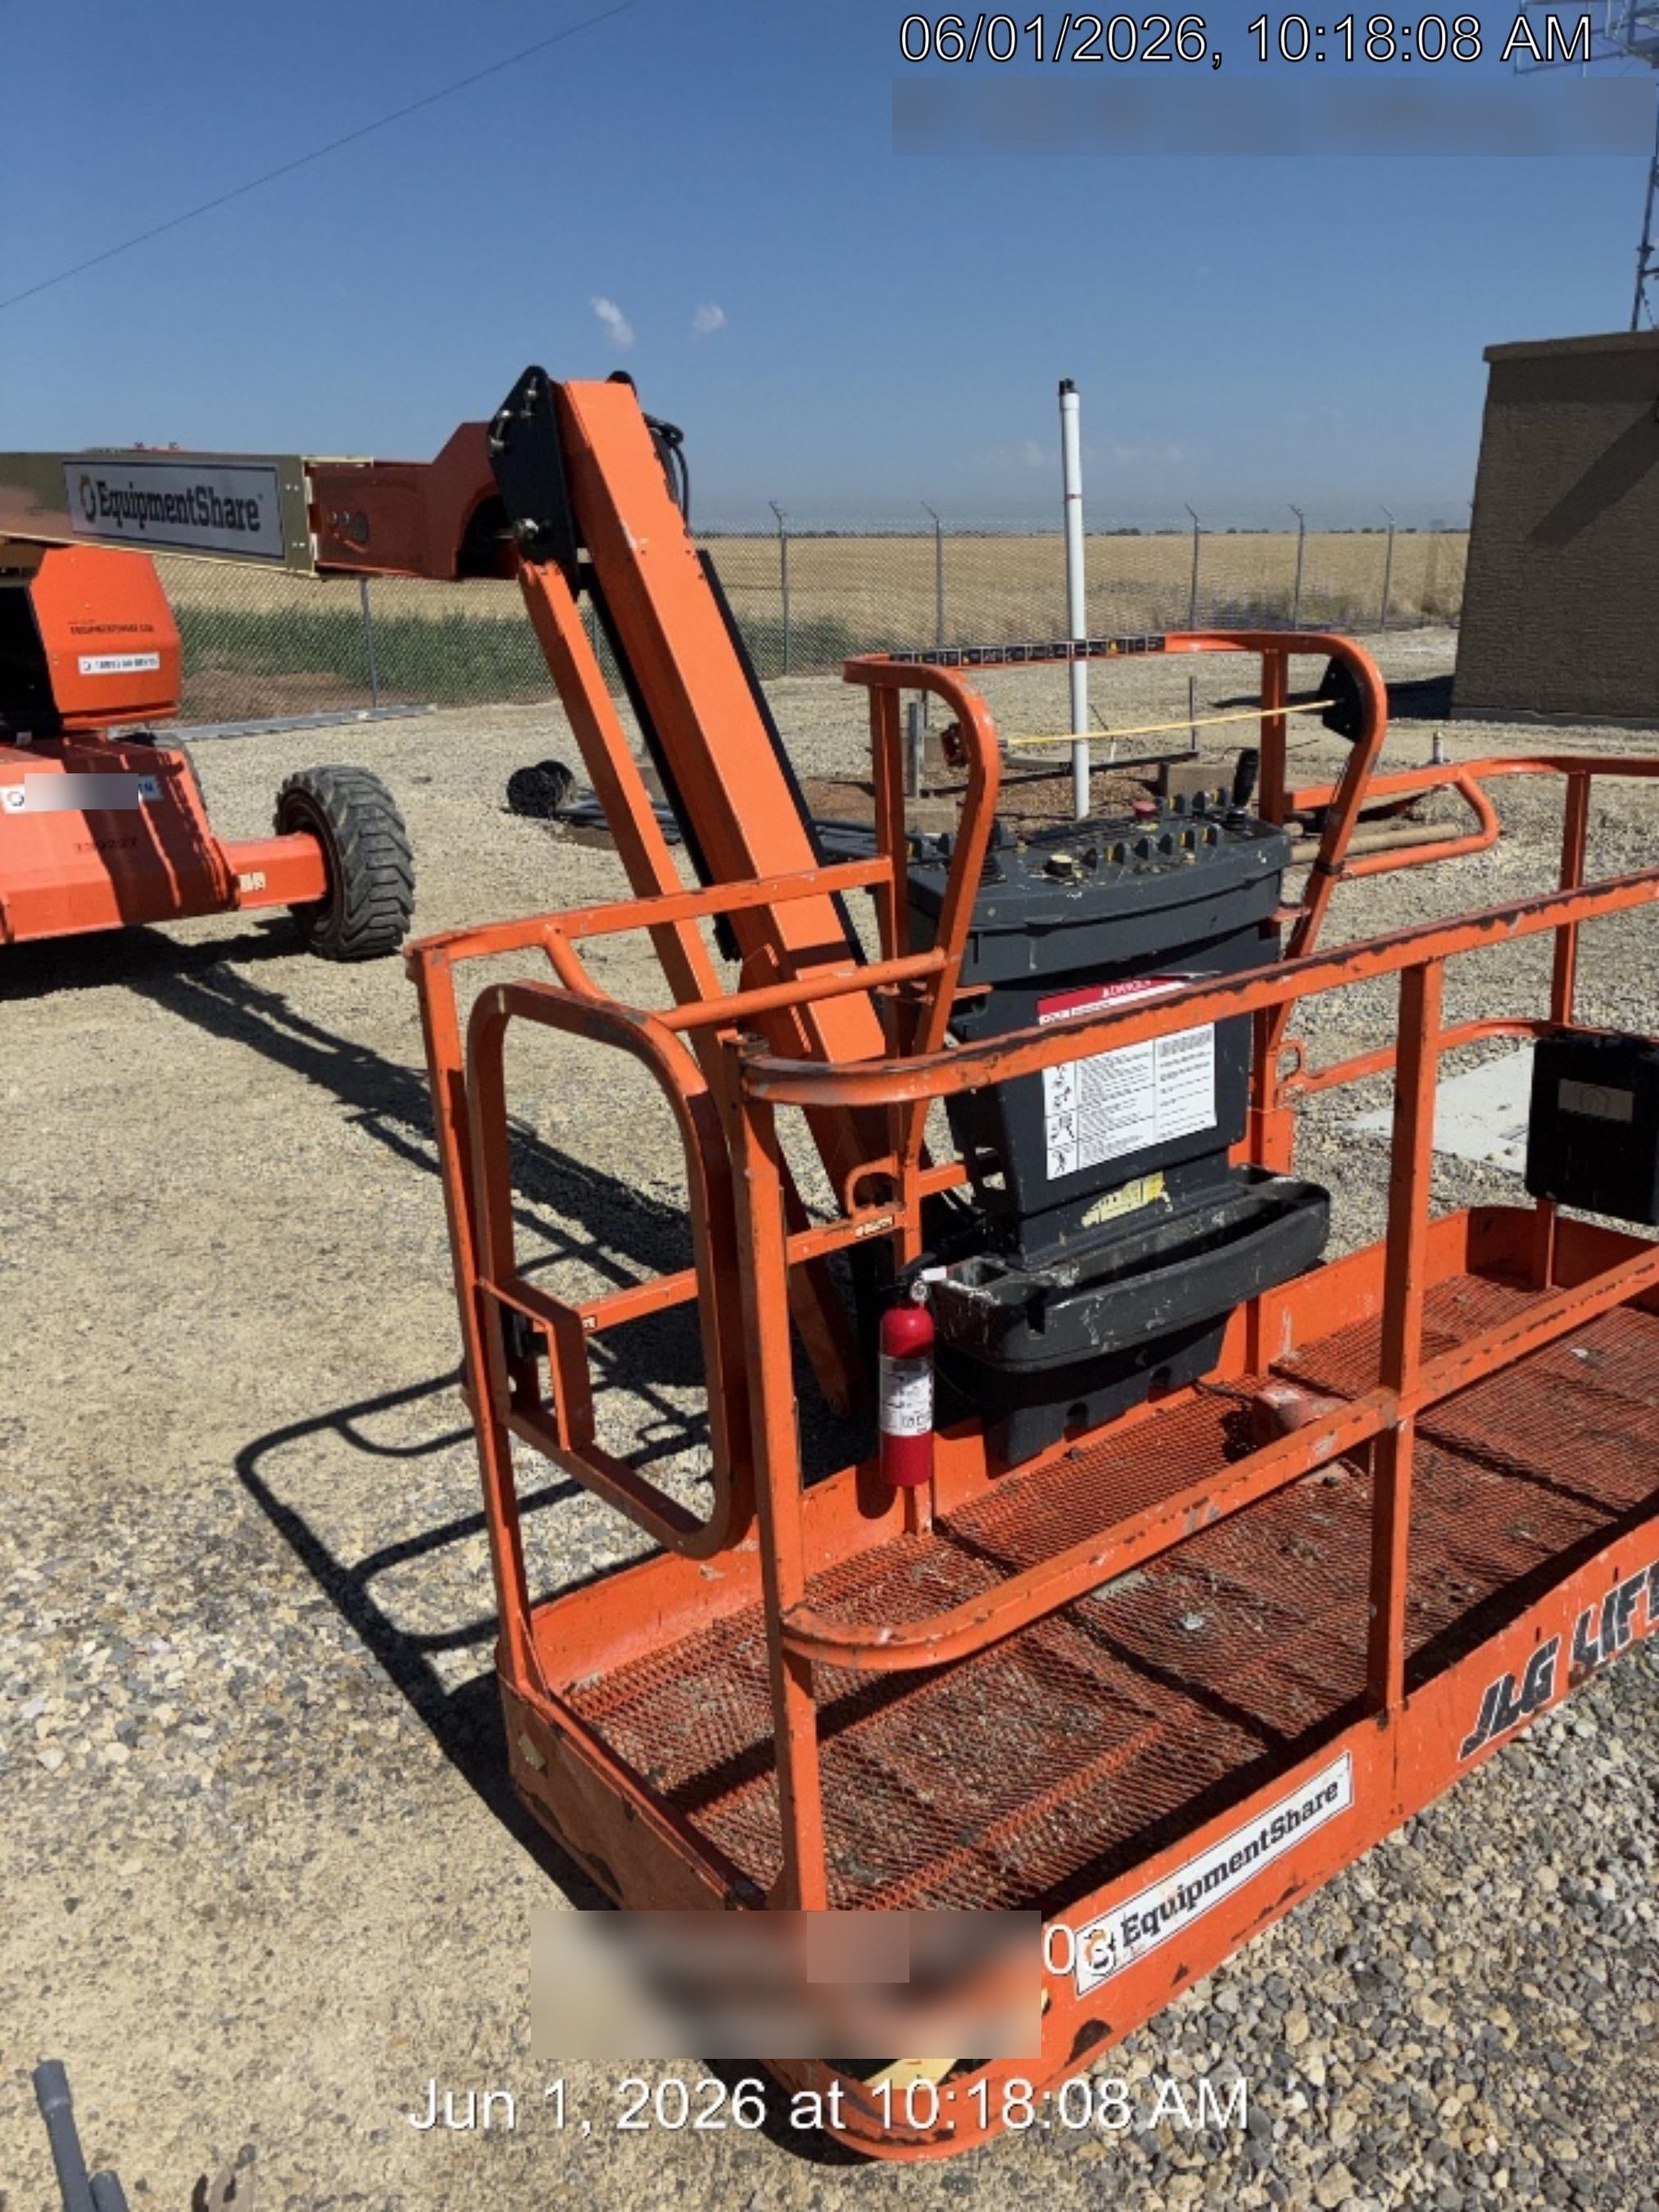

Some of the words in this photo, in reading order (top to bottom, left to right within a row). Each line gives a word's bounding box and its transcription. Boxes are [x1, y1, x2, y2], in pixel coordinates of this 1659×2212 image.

[96, 481, 261, 532] EquipmentShare
[1457, 1634, 1562, 1761] JLG
[1121, 1781, 1339, 1947] EquipmentShare
